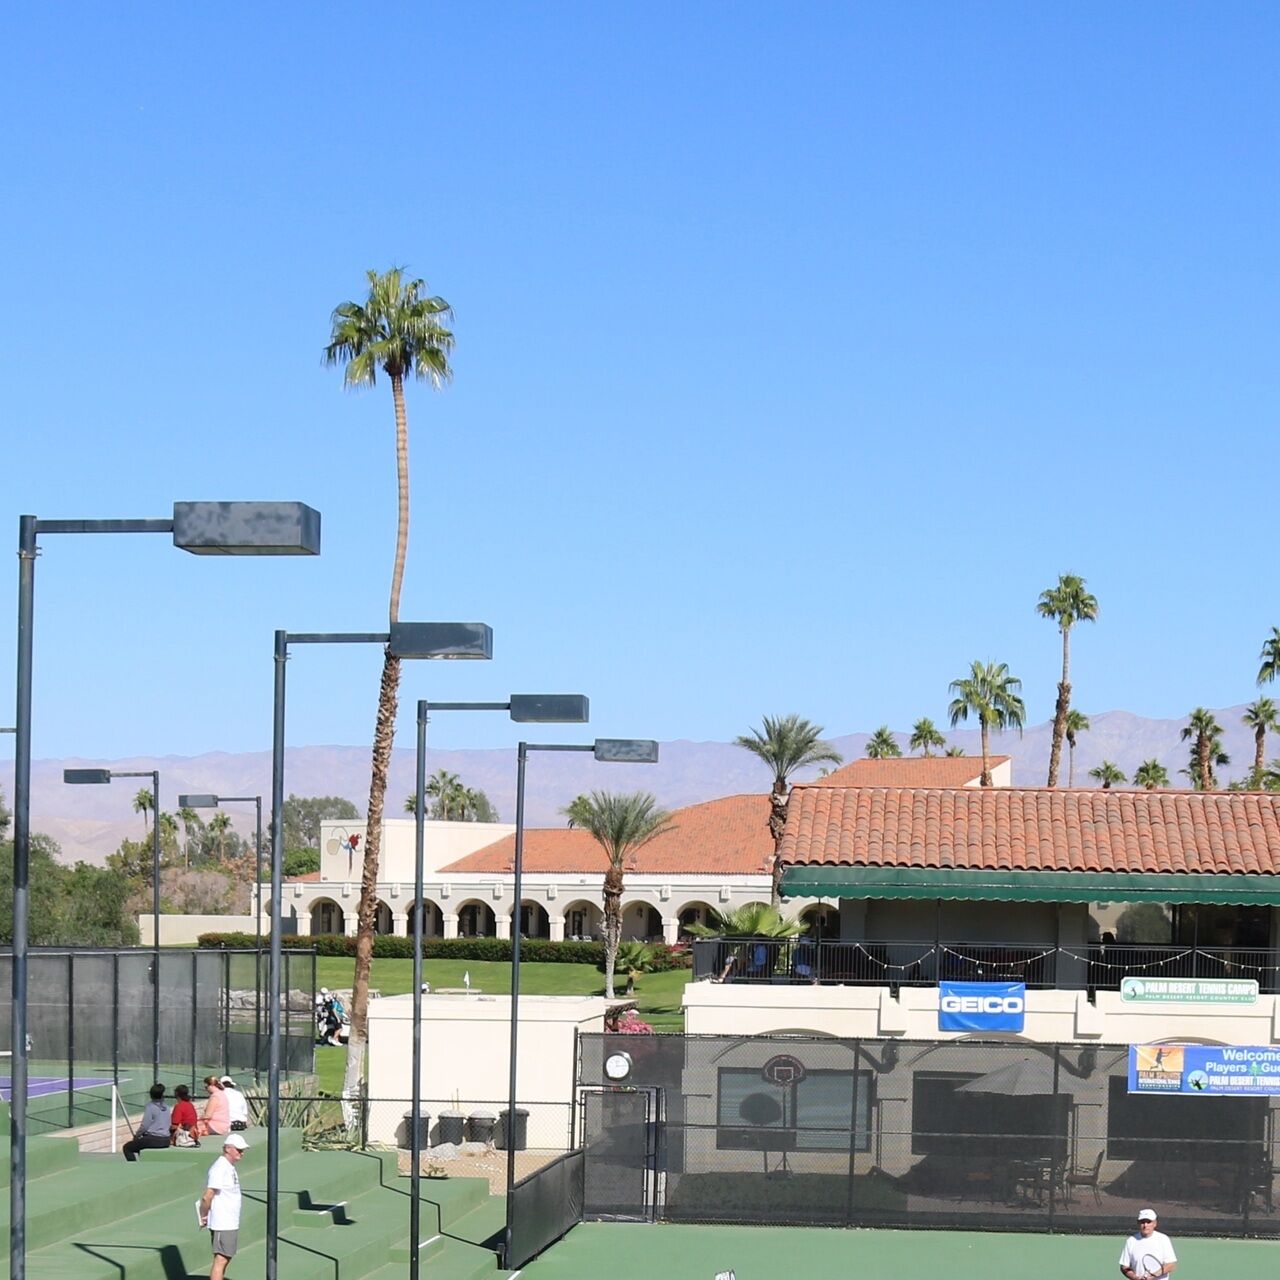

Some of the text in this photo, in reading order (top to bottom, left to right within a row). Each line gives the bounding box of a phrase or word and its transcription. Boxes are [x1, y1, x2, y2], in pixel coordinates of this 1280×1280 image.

[1145, 982, 1256, 996] PALM DESERT TENNIS CAMPS
[941, 996, 1023, 1013] GEICO
[1206, 1062, 1247, 1074] Players
[1209, 1075, 1229, 1085] PALM
[1230, 1076, 1253, 1086] DESERT
[1256, 1076, 1280, 1086] TENNIS
